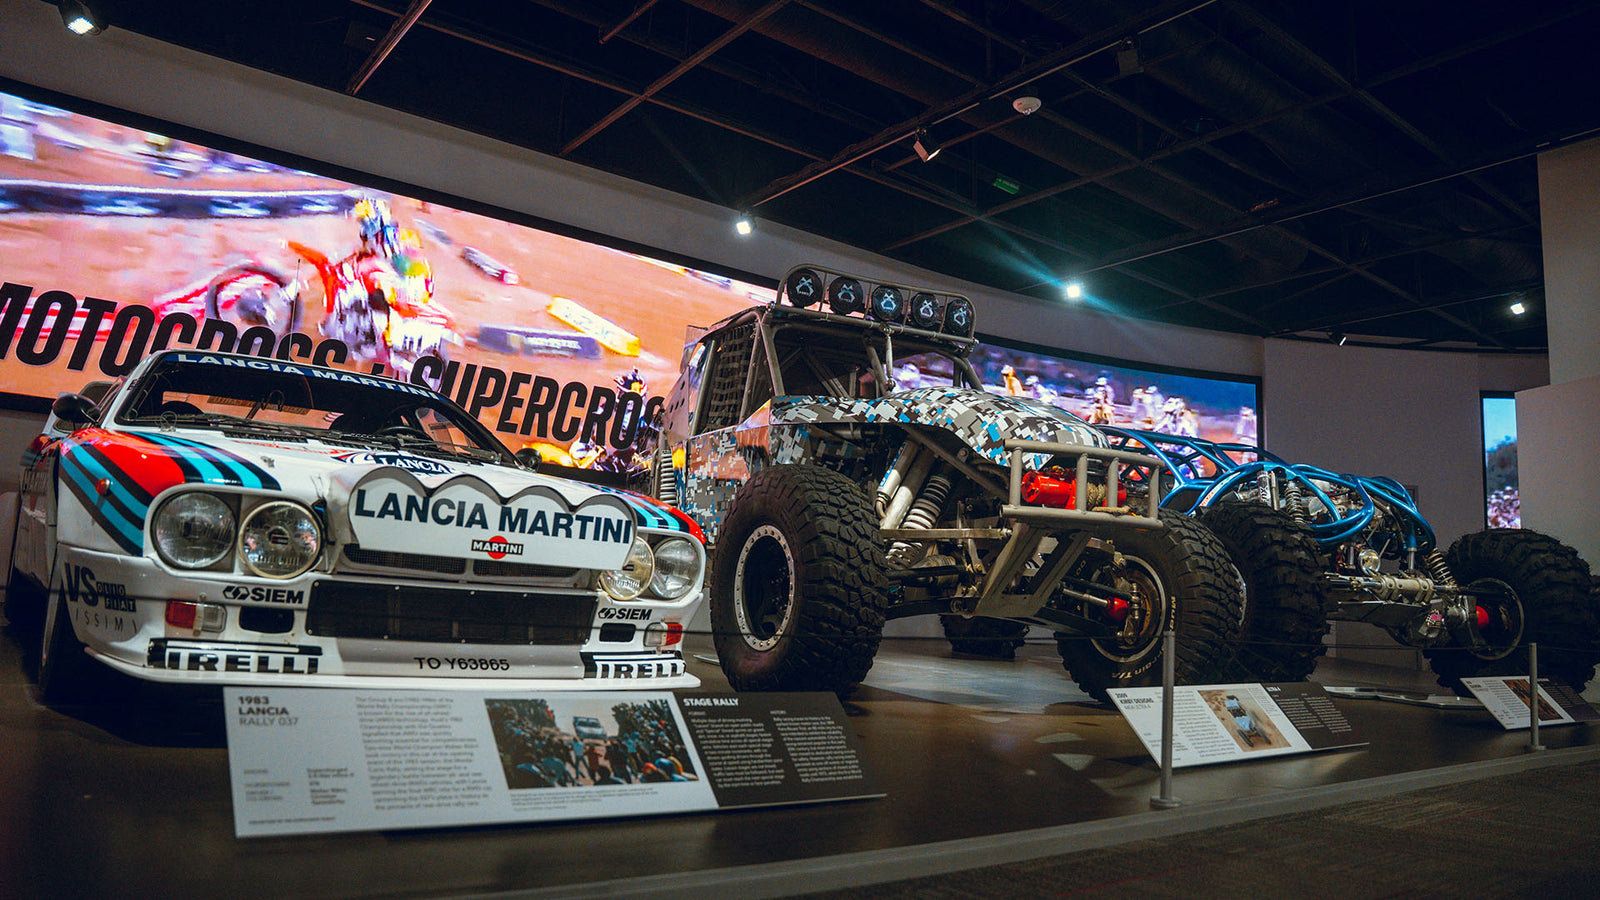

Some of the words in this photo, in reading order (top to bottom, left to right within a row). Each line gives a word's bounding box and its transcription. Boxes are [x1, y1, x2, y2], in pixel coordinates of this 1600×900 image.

[178, 353, 305, 376] LANCIA
[312, 369, 440, 400] MARTINI
[380, 456, 449, 474] LANCIA
[354, 489, 489, 530] LANCIA
[498, 506, 632, 544] MARTINI
[473, 541, 523, 555] MARTINI
[65, 562, 98, 606] VS
[97, 582, 126, 597] OLIO
[251, 586, 304, 604] SIEM
[105, 596, 136, 612] FIAT
[616, 608, 652, 620] SIEM
[414, 657, 441, 669] TO
[449, 657, 510, 671] Y63865
[238, 695, 270, 705] 1983
[683, 697, 713, 707] STAGE
[713, 697, 739, 706] RALLY
[238, 706, 289, 716] LANCIA
[239, 717, 275, 726] RALLY
[278, 717, 299, 726] 037
